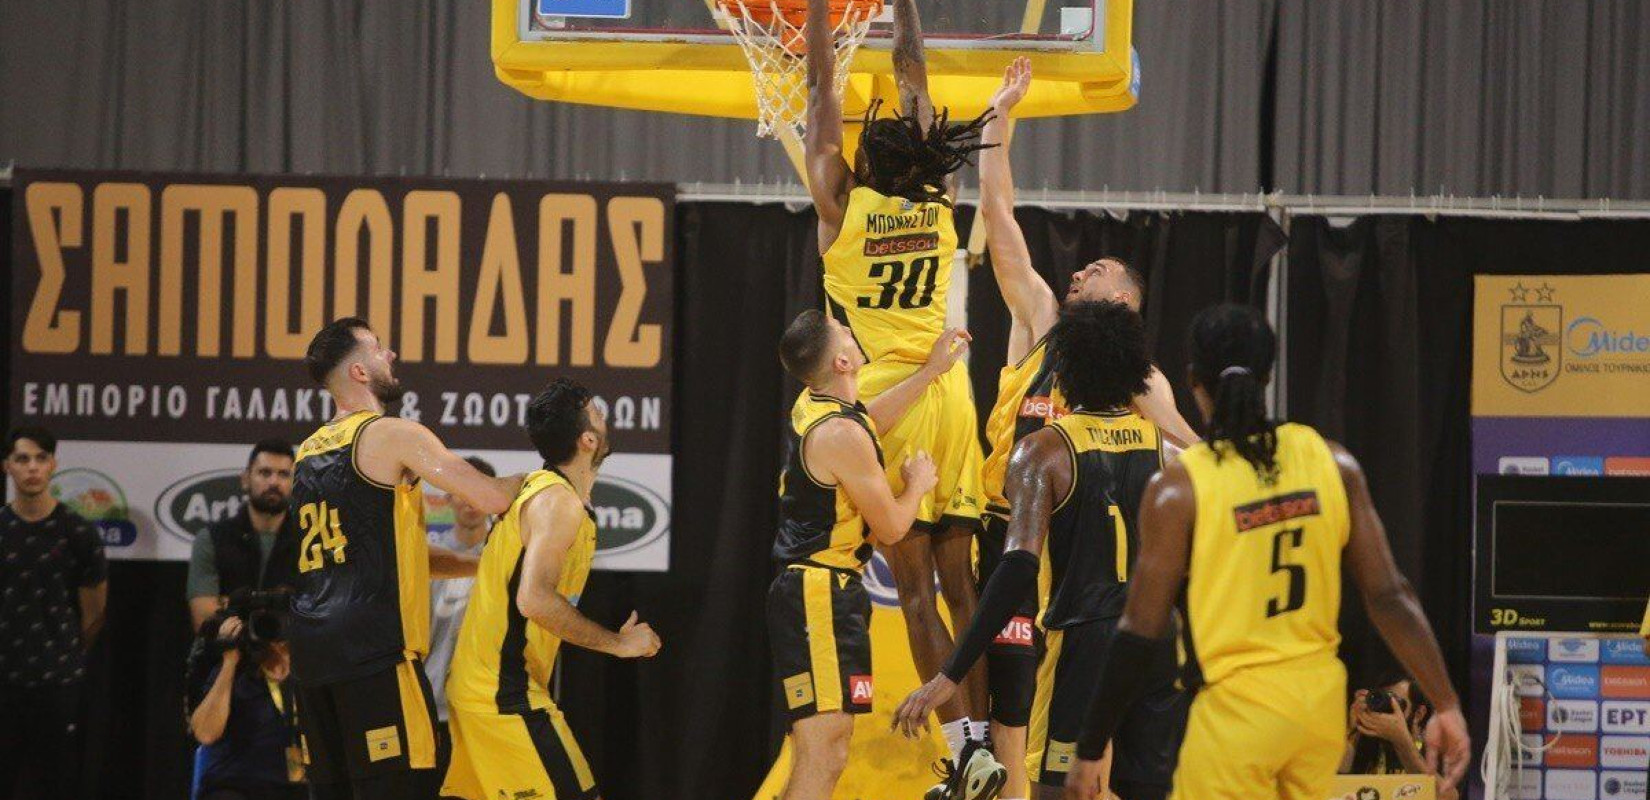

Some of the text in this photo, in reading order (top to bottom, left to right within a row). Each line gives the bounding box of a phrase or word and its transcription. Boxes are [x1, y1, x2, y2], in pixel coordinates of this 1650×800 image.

[866, 238, 938, 256] betsson
[857, 256, 939, 309] 30
[1588, 330, 1650, 353] Mide
[23, 382, 662, 430] ΕΜΠΟΡΙΟ ΓΑΛΑΚΤ & ΖΩΟΤΩΝ
[298, 500, 348, 573] 24
[1108, 505, 1129, 582] 1
[1265, 527, 1306, 618] 5
[1489, 608, 1518, 626] 3D
[997, 620, 1032, 640] VIS
[1616, 641, 1644, 652] Mide
[1560, 673, 1595, 686] Midea
[1603, 747, 1648, 756] TOSHIBA
